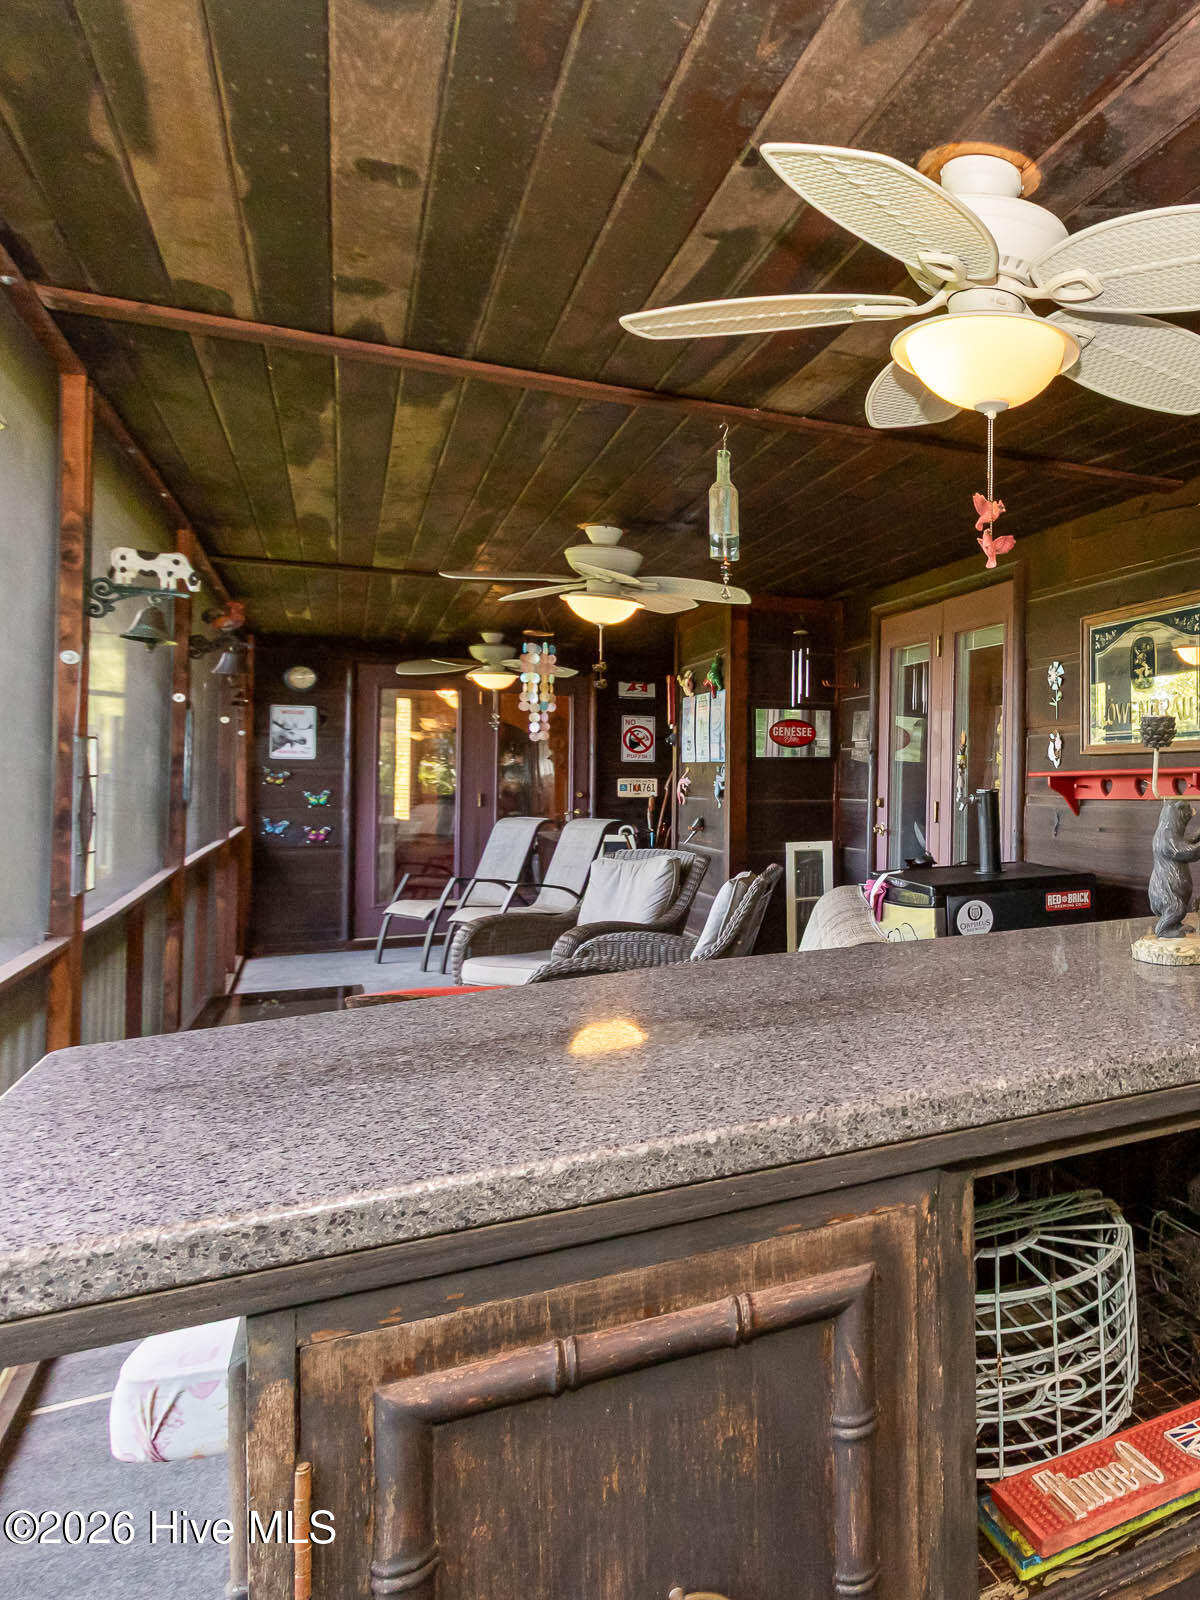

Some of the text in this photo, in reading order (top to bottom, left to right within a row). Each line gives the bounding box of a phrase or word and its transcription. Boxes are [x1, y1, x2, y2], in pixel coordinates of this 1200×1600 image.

[773, 726, 813, 737] GENESEE
[1047, 892, 1090, 906] RED BRICK
